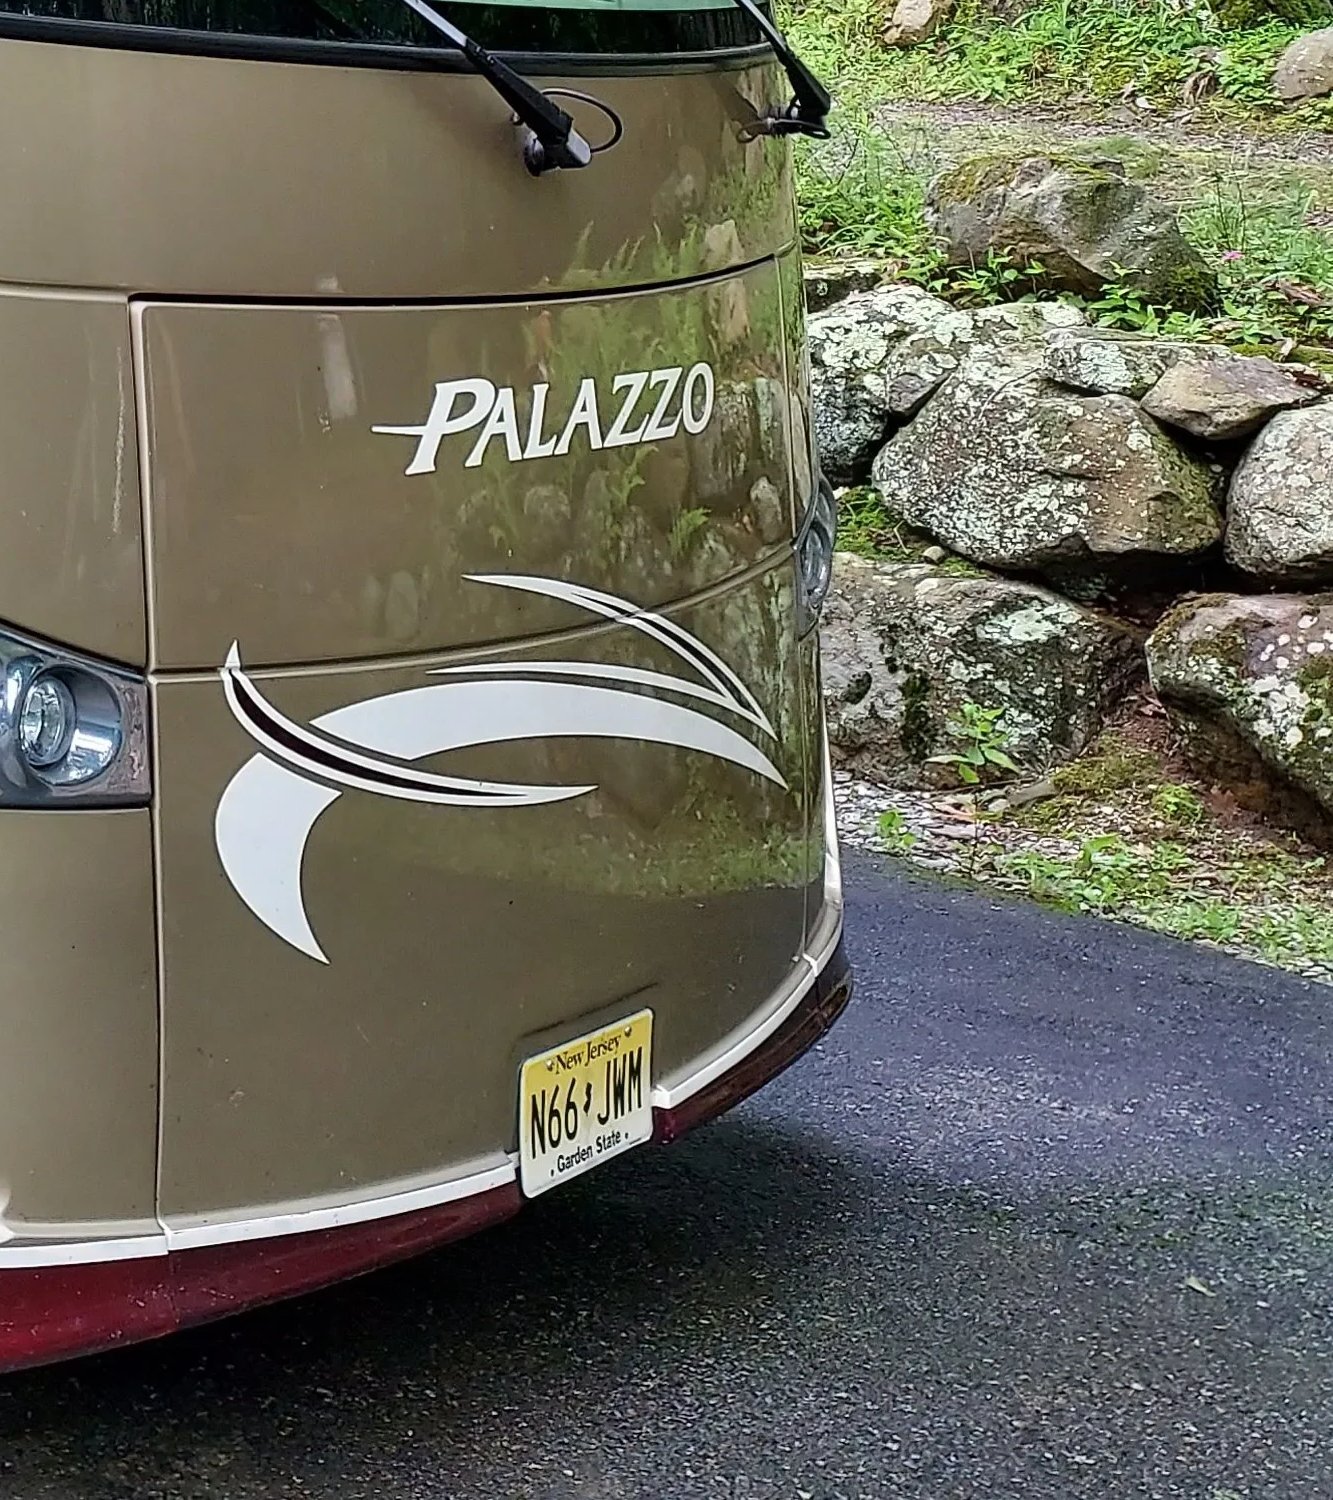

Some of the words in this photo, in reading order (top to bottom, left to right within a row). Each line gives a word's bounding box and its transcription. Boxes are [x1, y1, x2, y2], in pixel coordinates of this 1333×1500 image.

[371, 361, 715, 476] PALAZZO
[555, 1051, 584, 1075] New
[584, 1034, 621, 1067] Jersey
[531, 1077, 578, 1159] N66
[597, 1046, 643, 1125] JWM
[557, 1145, 593, 1173] Garden
[595, 1129, 622, 1154] State
